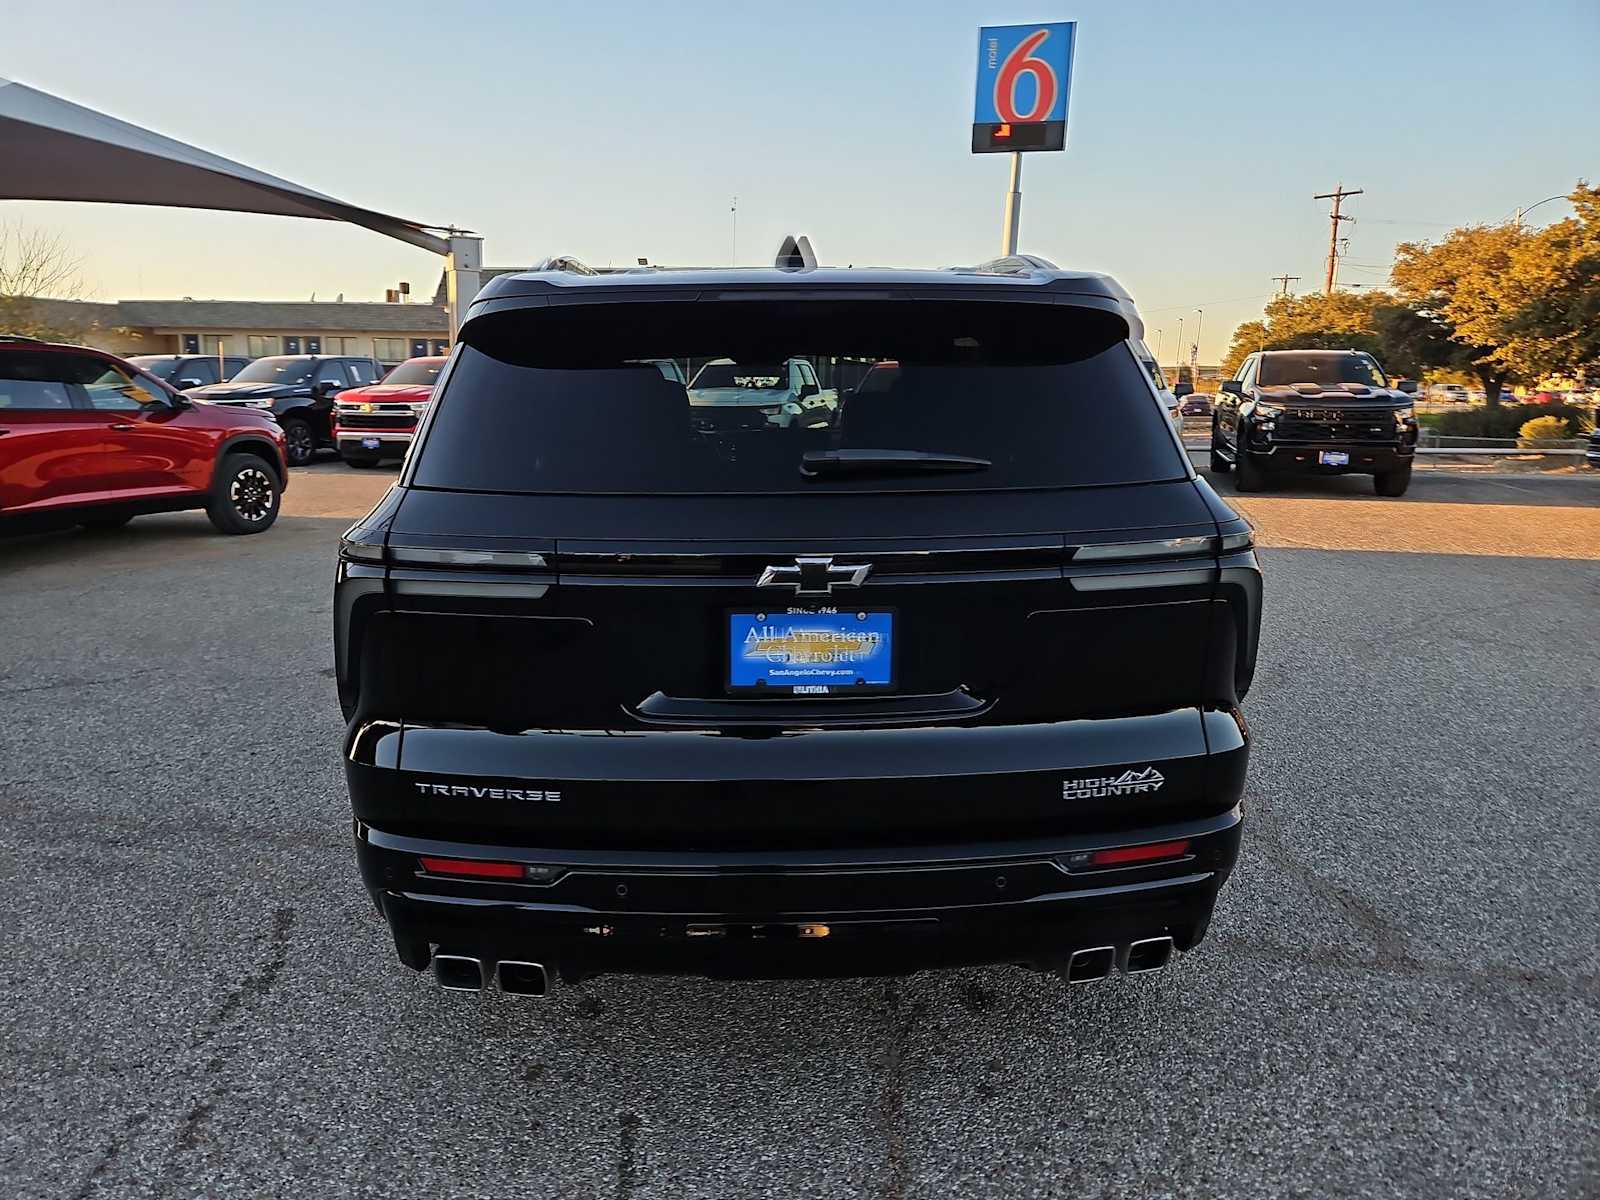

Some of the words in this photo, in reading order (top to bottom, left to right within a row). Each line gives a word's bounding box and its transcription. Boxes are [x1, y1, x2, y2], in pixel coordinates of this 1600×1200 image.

[993, 28, 1058, 123] 6
[414, 782, 562, 802] TRAVERSE
[1062, 776, 1116, 791] HIGH
[1062, 781, 1164, 800] COUNTRY
